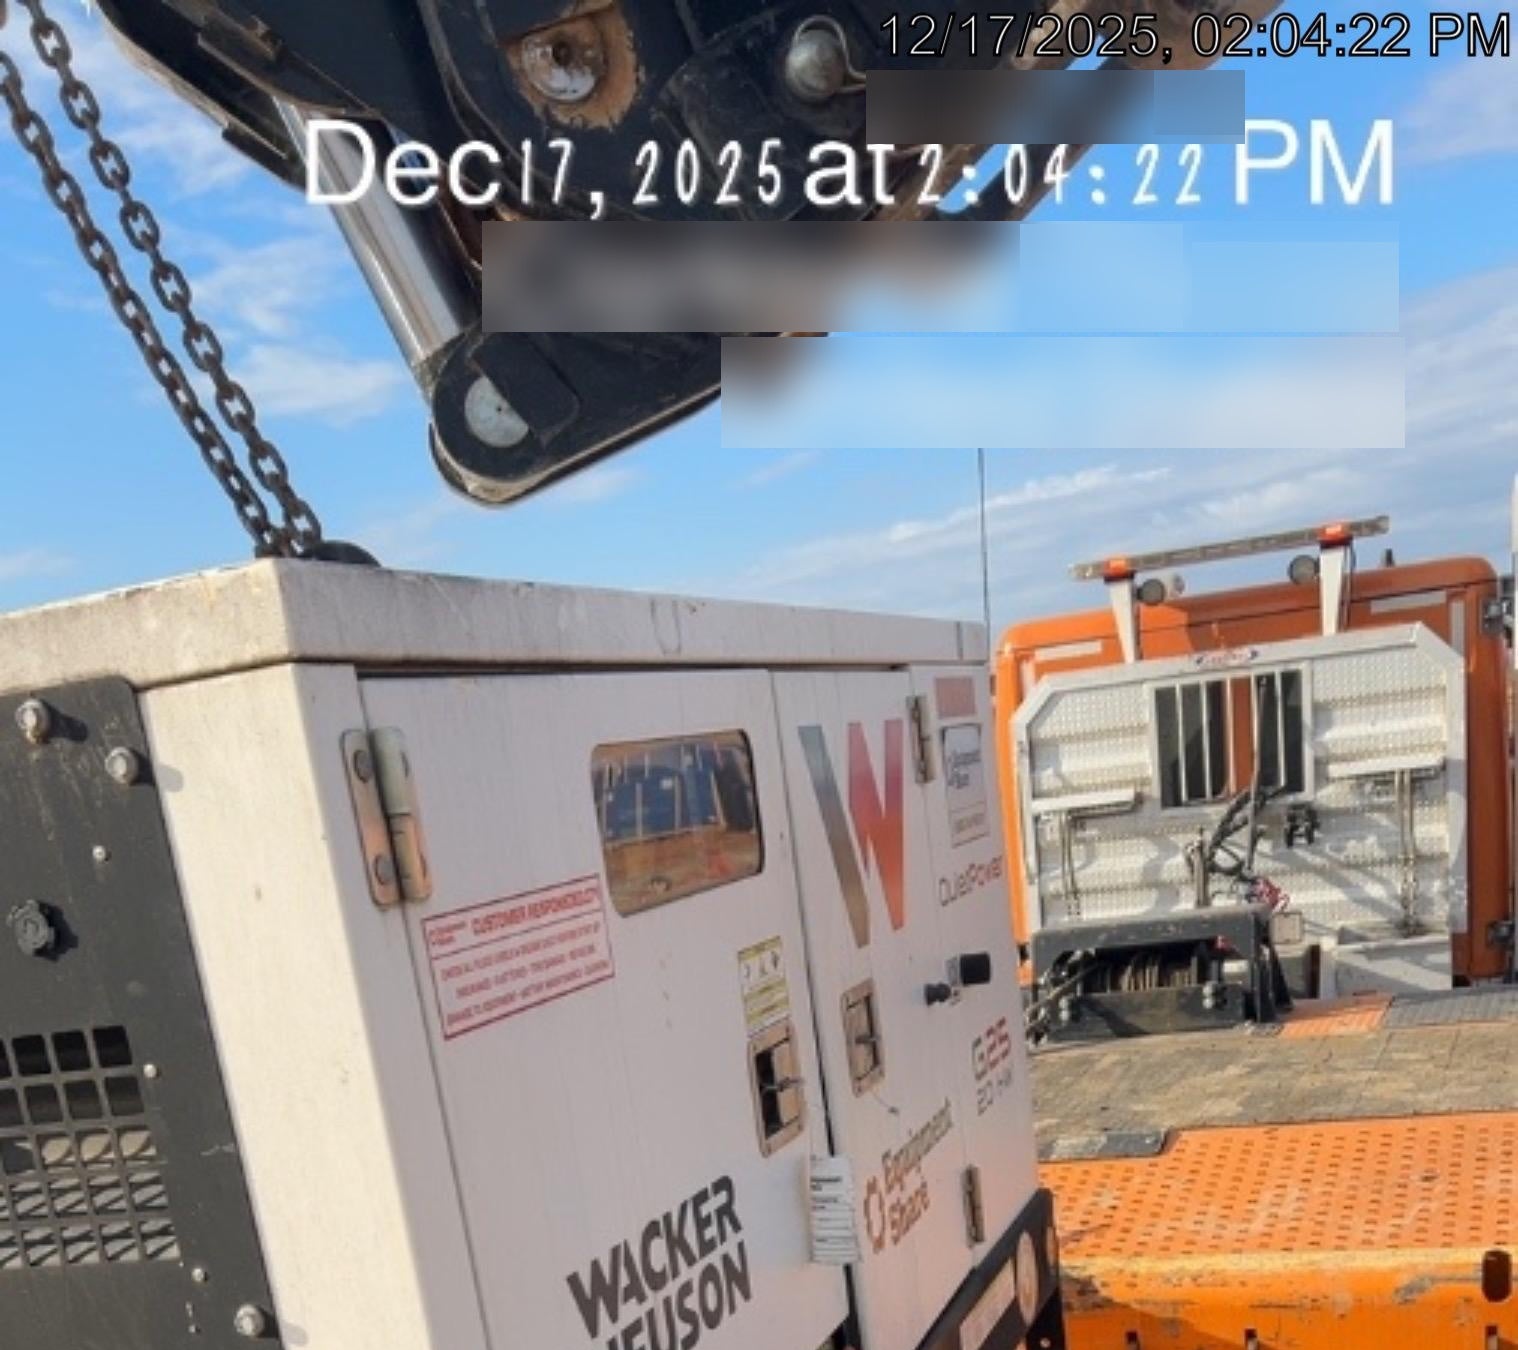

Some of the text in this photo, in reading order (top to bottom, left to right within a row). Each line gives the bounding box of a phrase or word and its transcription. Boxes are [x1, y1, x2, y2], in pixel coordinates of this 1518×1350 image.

[971, 1016, 1012, 1081] G25
[881, 1096, 953, 1195] Equipment
[889, 1176, 929, 1247] Share
[566, 1175, 742, 1339] WACKER
